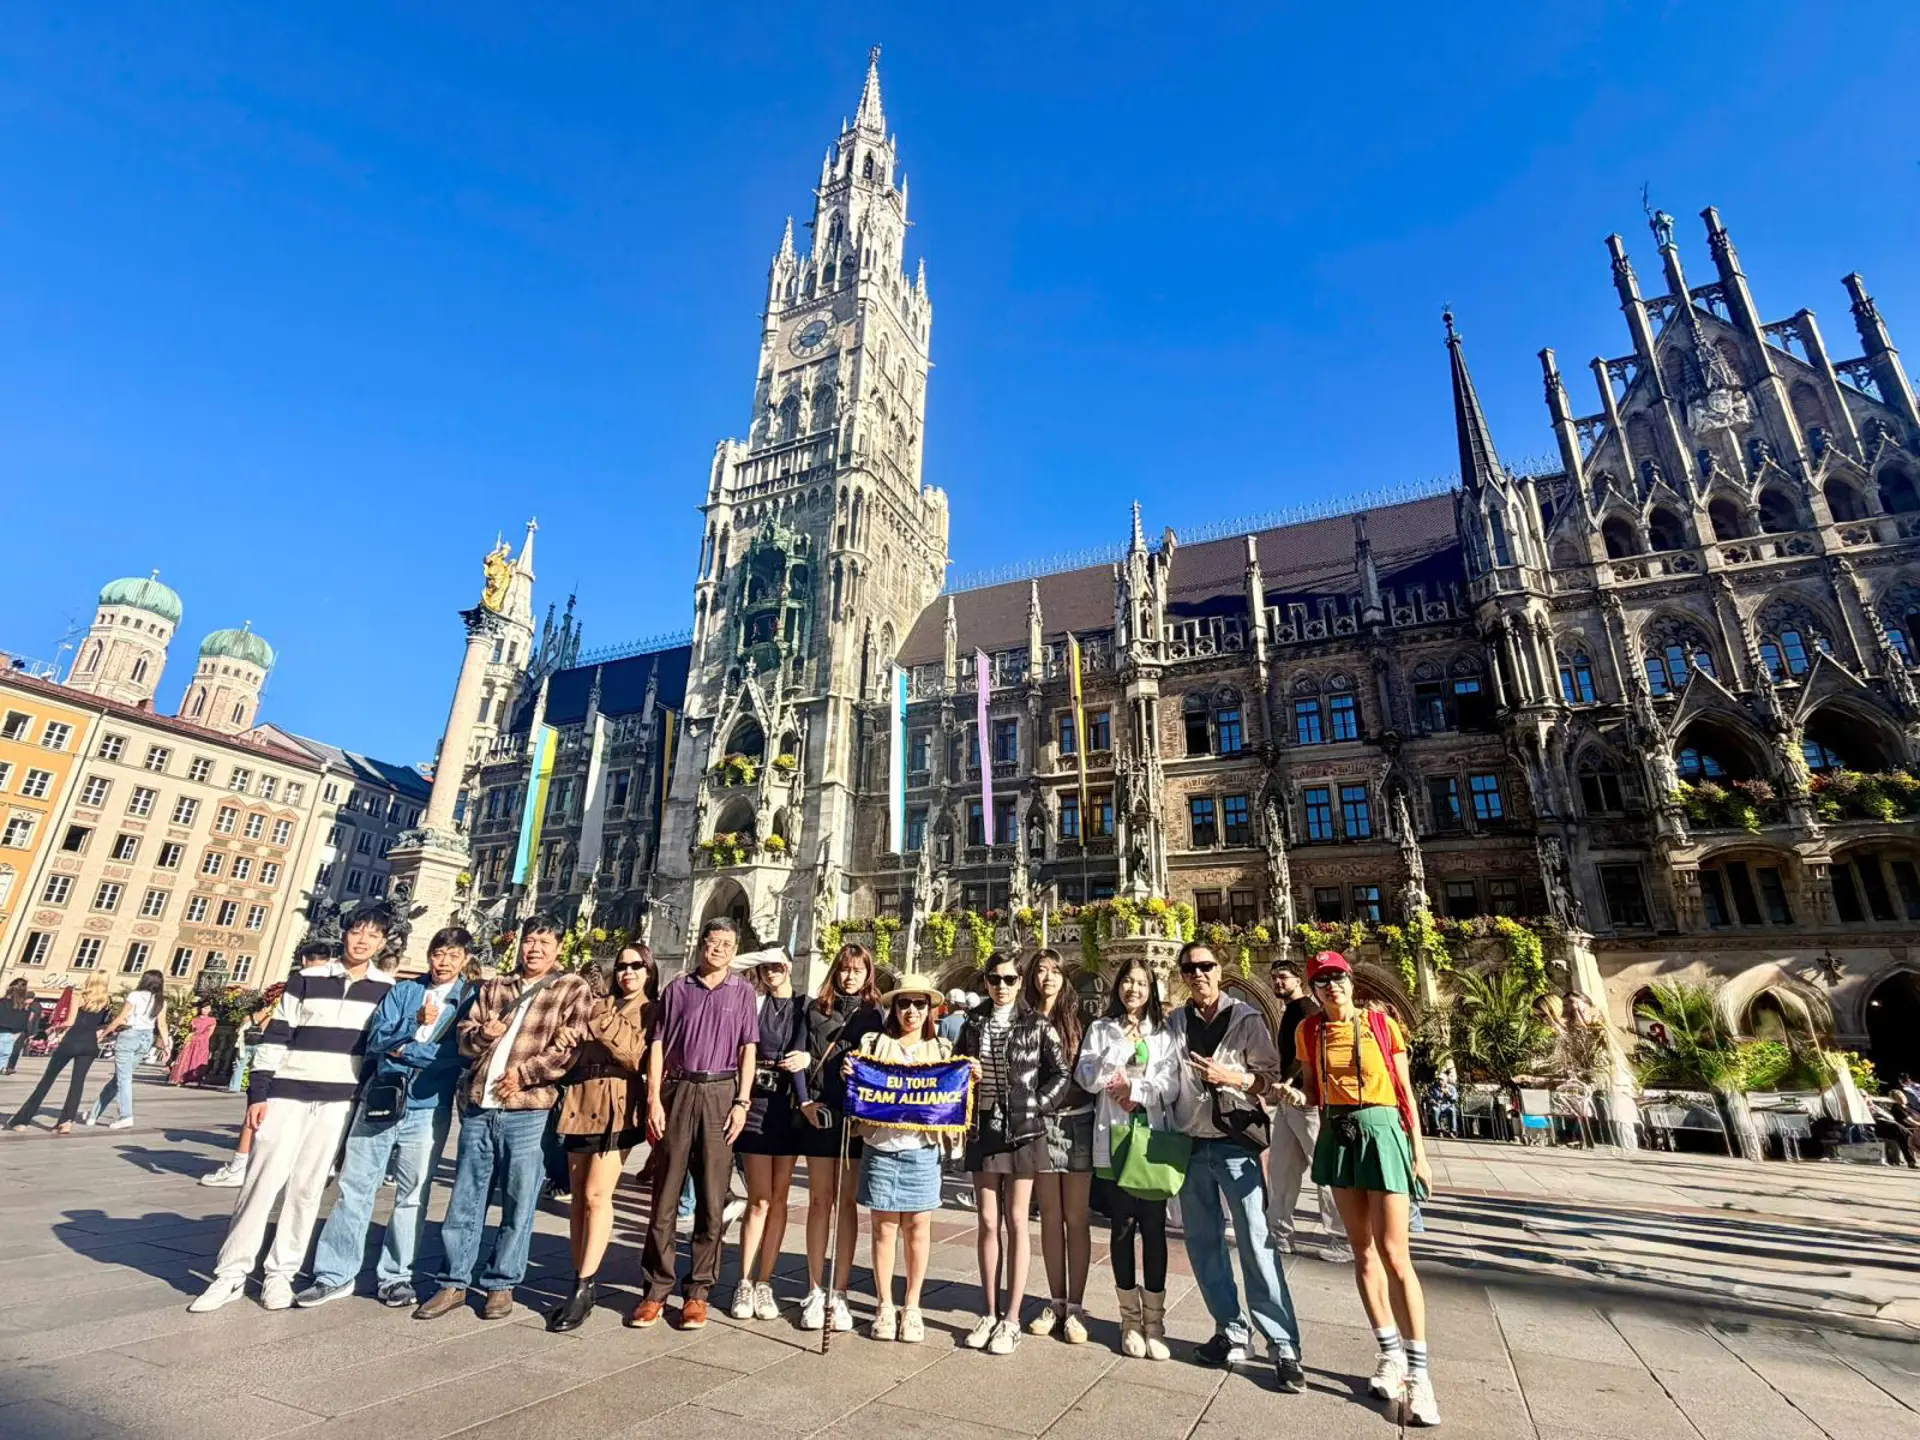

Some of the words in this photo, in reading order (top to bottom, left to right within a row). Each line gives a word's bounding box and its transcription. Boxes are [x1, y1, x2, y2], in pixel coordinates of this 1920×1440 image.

[887, 1076, 902, 1088] EU
[906, 1077, 938, 1089] TOUR
[858, 1087, 896, 1104] TEAM
[899, 1090, 962, 1105] ALLIANCE
